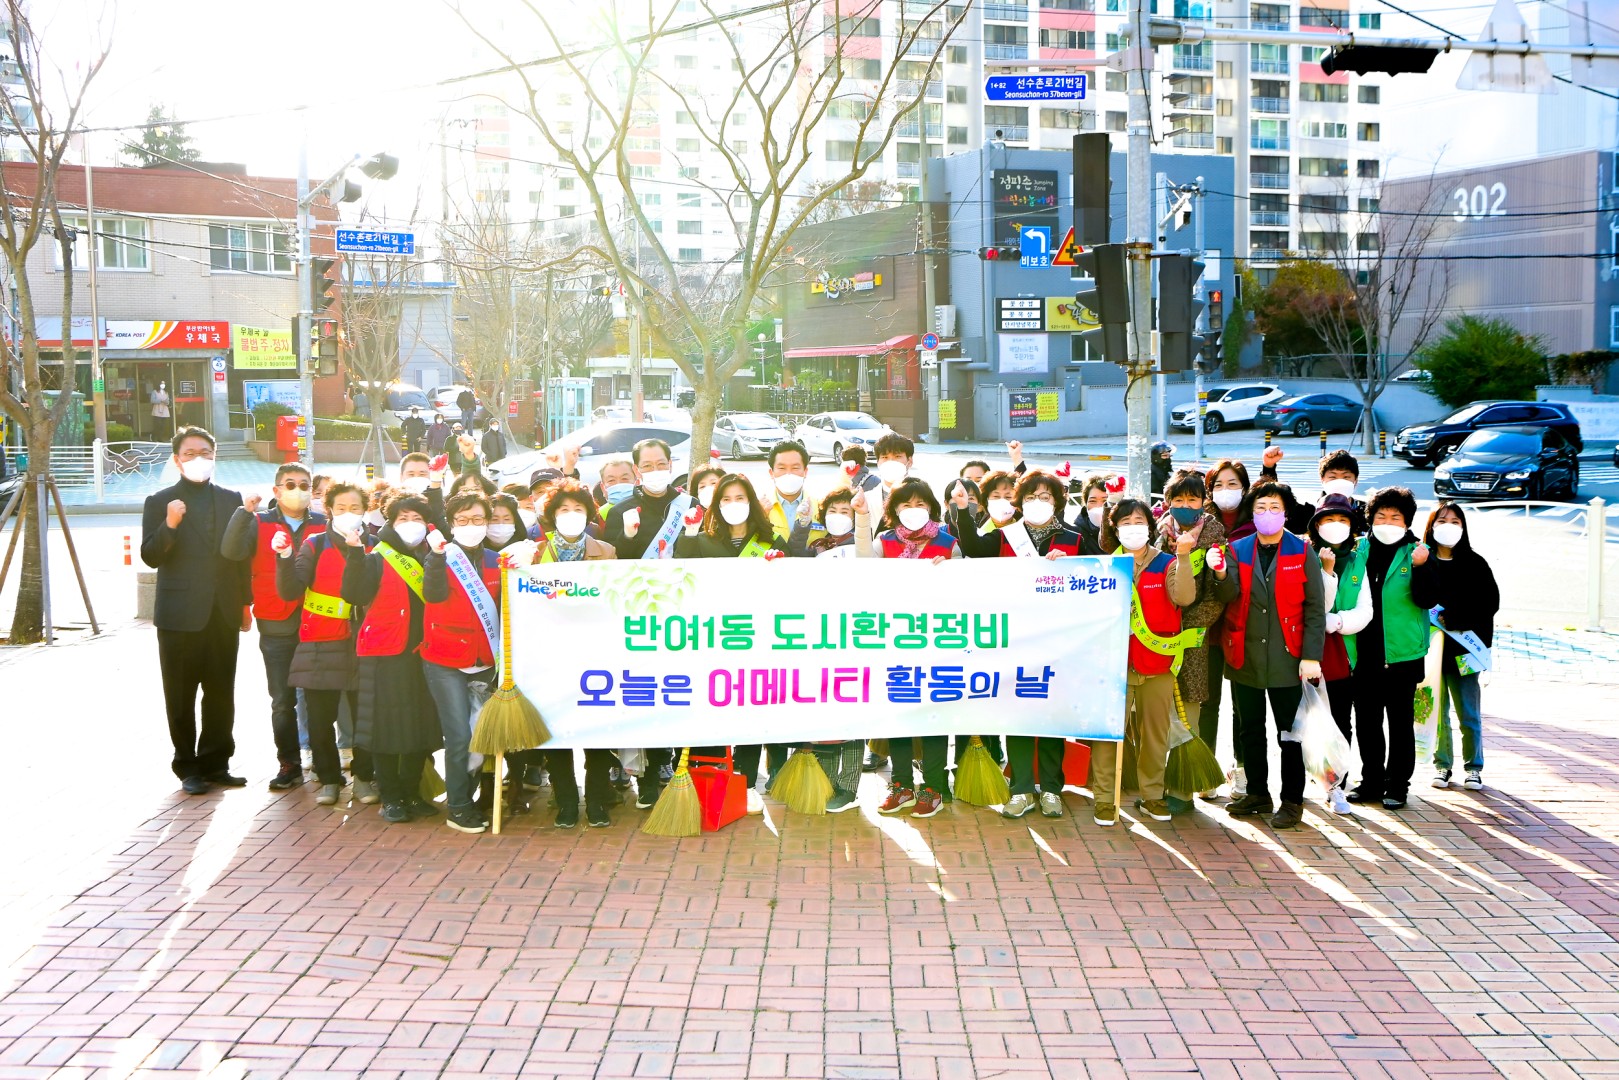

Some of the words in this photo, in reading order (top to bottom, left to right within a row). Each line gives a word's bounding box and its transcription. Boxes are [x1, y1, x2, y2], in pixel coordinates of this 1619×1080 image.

[1004, 90, 1049, 99] Seonsuchon-ro
[1049, 90, 1083, 99] 37beon-gil
[1000, 175, 1033, 191] 점핑존
[1453, 182, 1508, 223] 302
[1021, 255, 1048, 267] 비보호
[185, 333, 221, 344] 우체국
[530, 577, 573, 587] Sun&Fun
[1035, 575, 1065, 585] 사람중심
[1068, 575, 1117, 595] 해운대
[1035, 586, 1065, 594] 미래도시
[623, 614, 756, 652] 반여1동
[773, 611, 1009, 650] 도시환경정비
[578, 669, 692, 707] 오늘은
[708, 667, 870, 707] 어메니티
[886, 665, 999, 702] 활동의
[1015, 665, 1055, 699] 날
